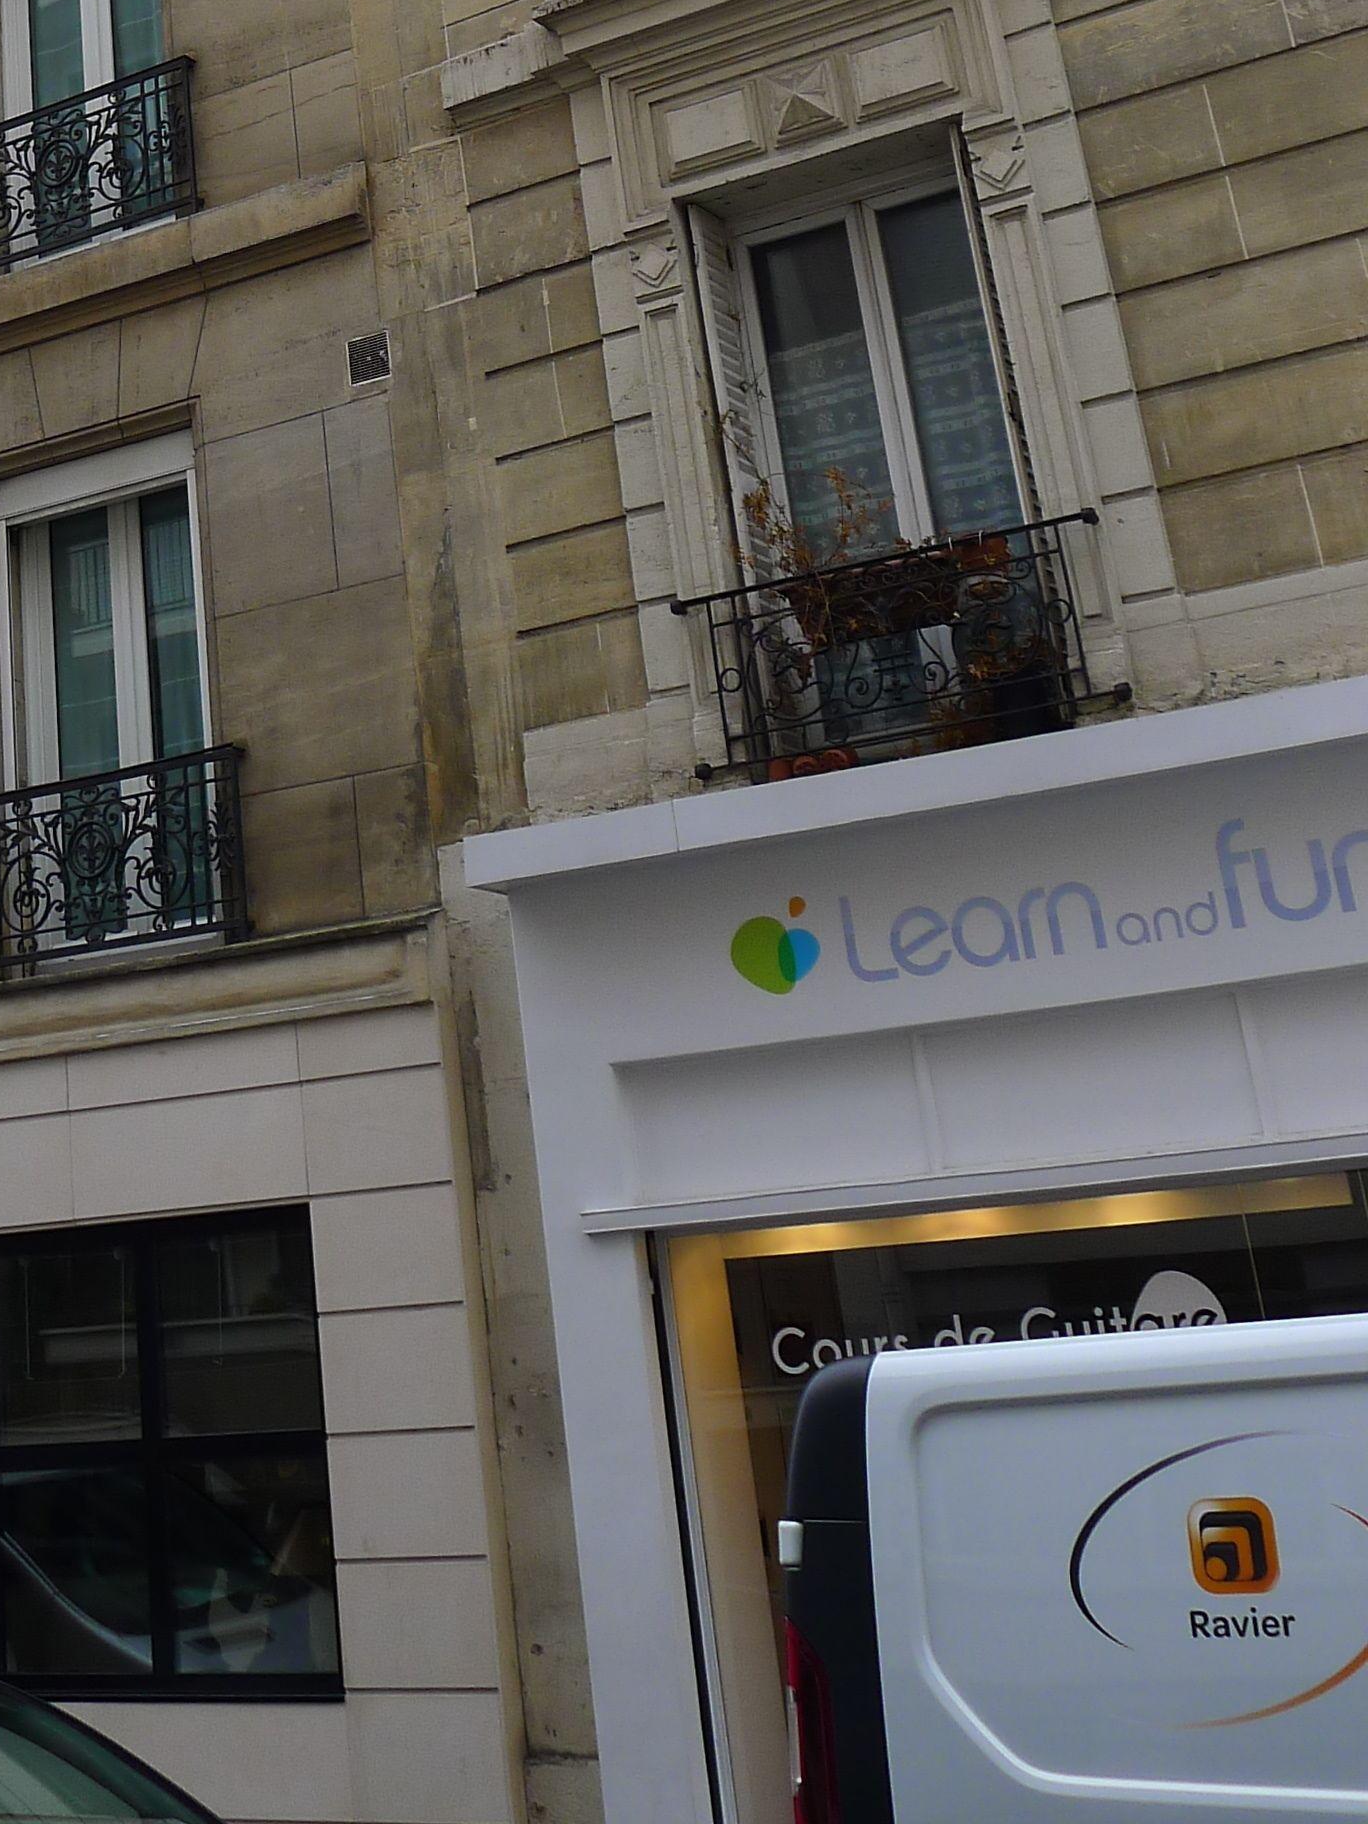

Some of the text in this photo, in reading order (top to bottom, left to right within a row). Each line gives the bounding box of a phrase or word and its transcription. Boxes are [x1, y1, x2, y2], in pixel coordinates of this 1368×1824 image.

[838, 880, 1108, 983] Learn
[1116, 891, 1219, 947] and
[1189, 1606, 1296, 1639] Ravier
